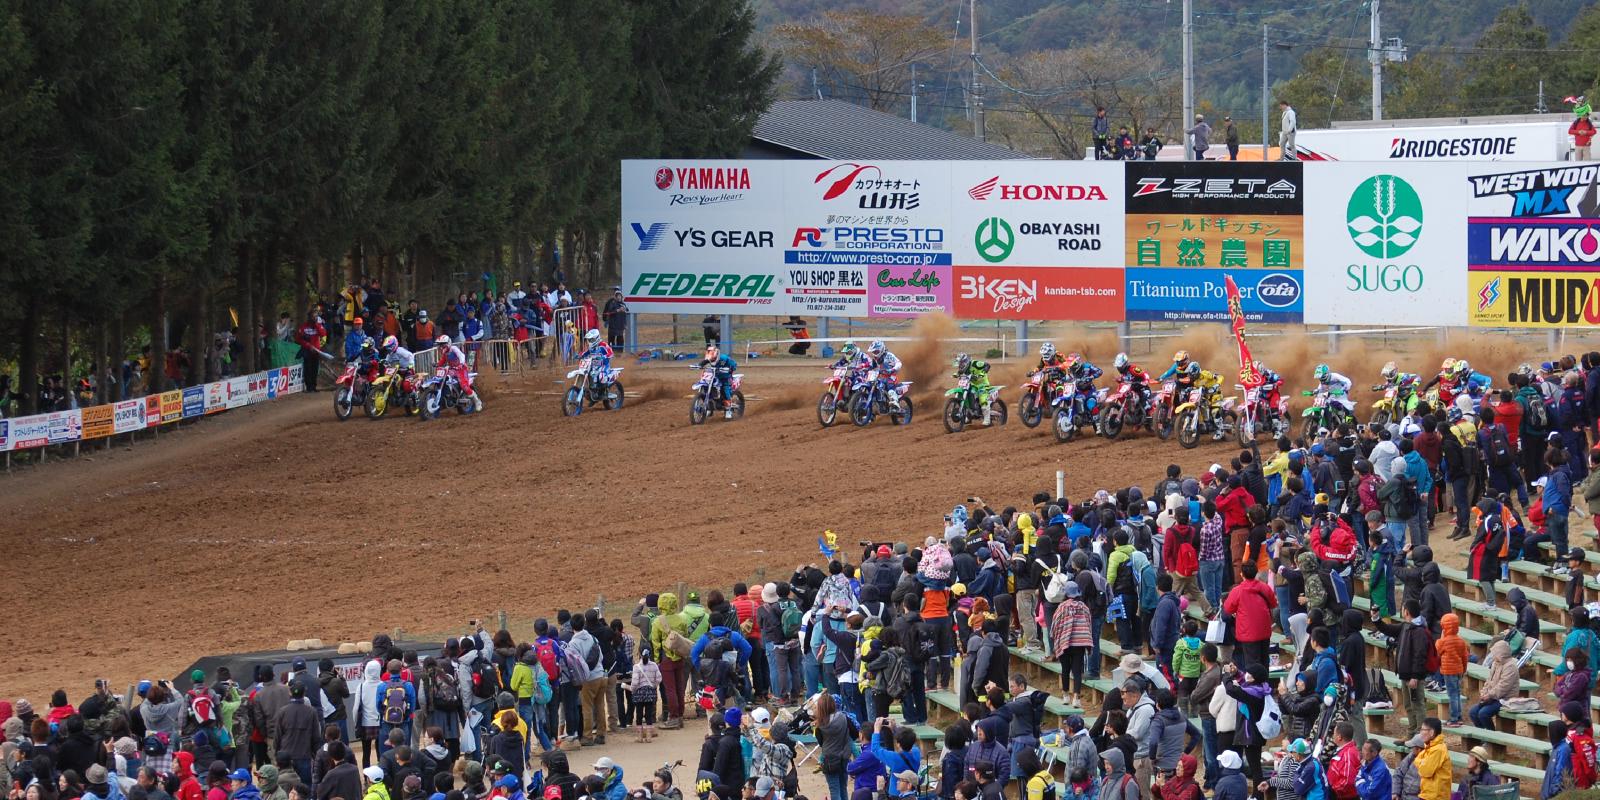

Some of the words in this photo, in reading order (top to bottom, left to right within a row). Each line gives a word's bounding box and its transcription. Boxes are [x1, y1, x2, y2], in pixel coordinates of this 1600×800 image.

[1389, 137, 1517, 158] BRIDGESTONE
[676, 168, 751, 189] YAMAHA
[854, 179, 921, 190] カワサキオート
[1172, 178, 1296, 193] ZETA
[670, 193, 699, 206] Revs
[699, 195, 719, 205] Your
[720, 193, 744, 202] Heart
[1000, 185, 1108, 200] HONDA
[858, 192, 920, 210] 山形
[1513, 187, 1572, 216] MX
[826, 214, 909, 225] 夢のマシンを世界から
[1146, 217, 1281, 236] ワールドキッチン
[834, 227, 944, 242] PRESTO
[1020, 223, 1100, 235] OBAYASHI
[674, 228, 707, 247] Y'S
[711, 231, 774, 247] GEAR
[1058, 239, 1101, 250] ROAD
[846, 242, 931, 250] CORPORATION
[1137, 237, 1291, 267] 自然農園
[798, 252, 938, 265] http://www.presto-corp.jp/
[630, 273, 777, 297] FEDERAL
[789, 271, 808, 286] YOU
[811, 271, 835, 286] SHOP
[838, 270, 863, 287] 黒松
[908, 268, 940, 293] Life
[1346, 264, 1423, 292] SUGO
[1044, 286, 1117, 296] kanban-tsb.com
[1129, 280, 1200, 297] Titanium
[1203, 281, 1254, 298] Poer
[1261, 283, 1295, 297] ofa
[993, 294, 1032, 313] Design
[1164, 312, 1263, 320] http://www.ofa-titan.com/
